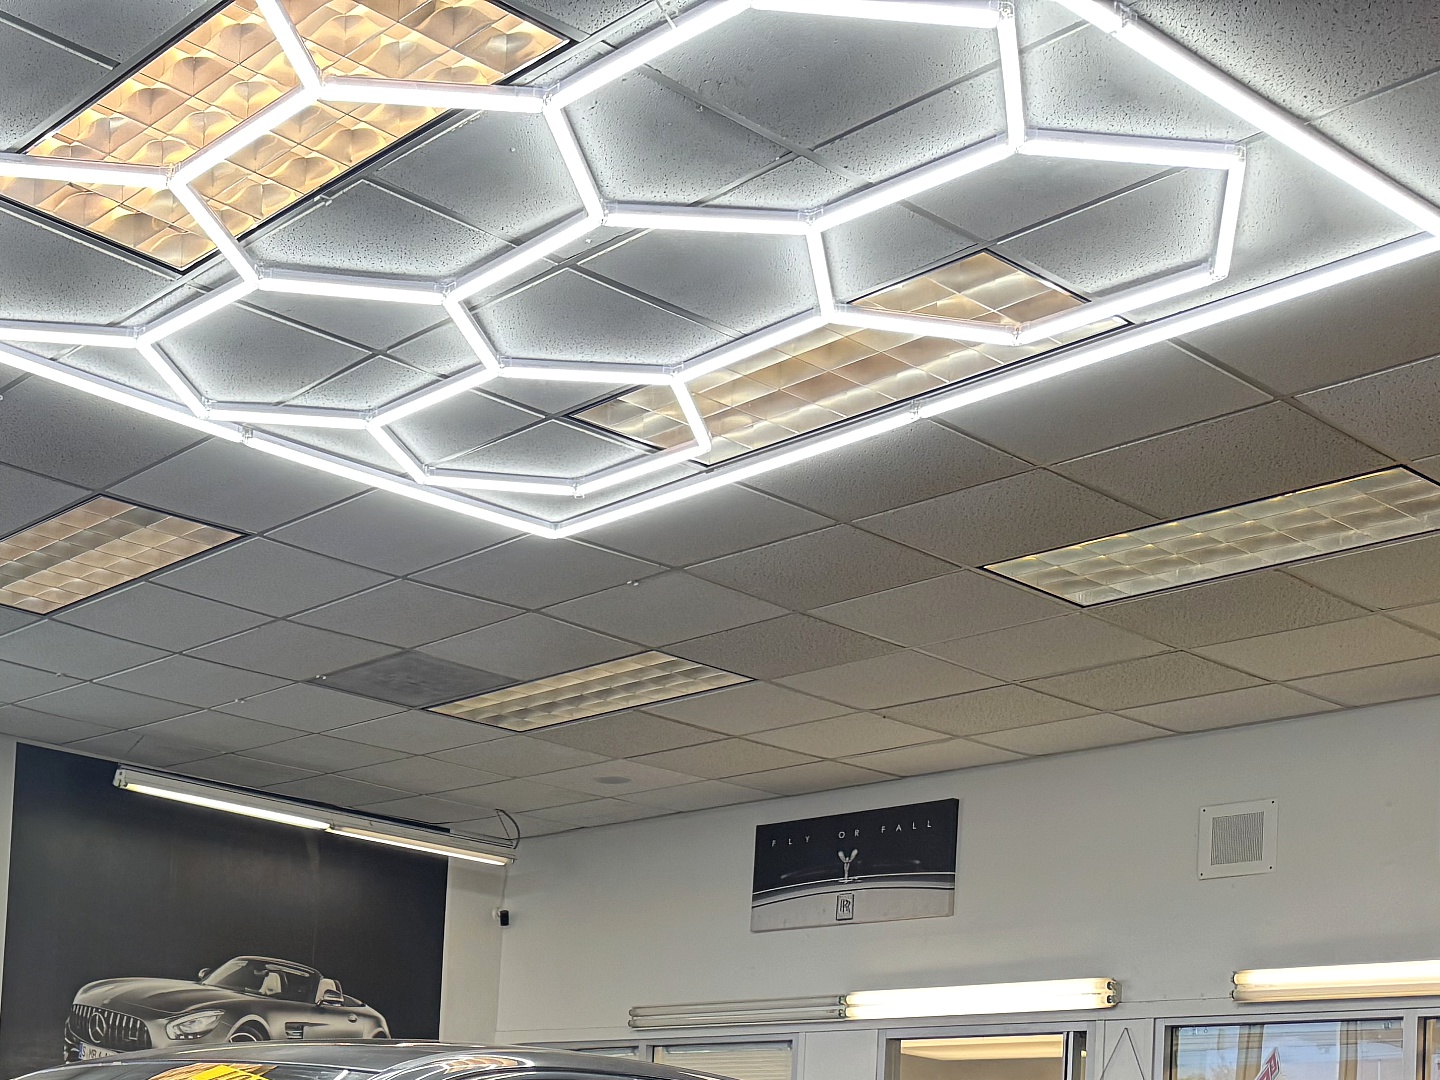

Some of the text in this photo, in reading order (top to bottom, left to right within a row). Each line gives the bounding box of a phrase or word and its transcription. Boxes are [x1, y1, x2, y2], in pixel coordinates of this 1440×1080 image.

[771, 820, 932, 847] FLY OR FALL
